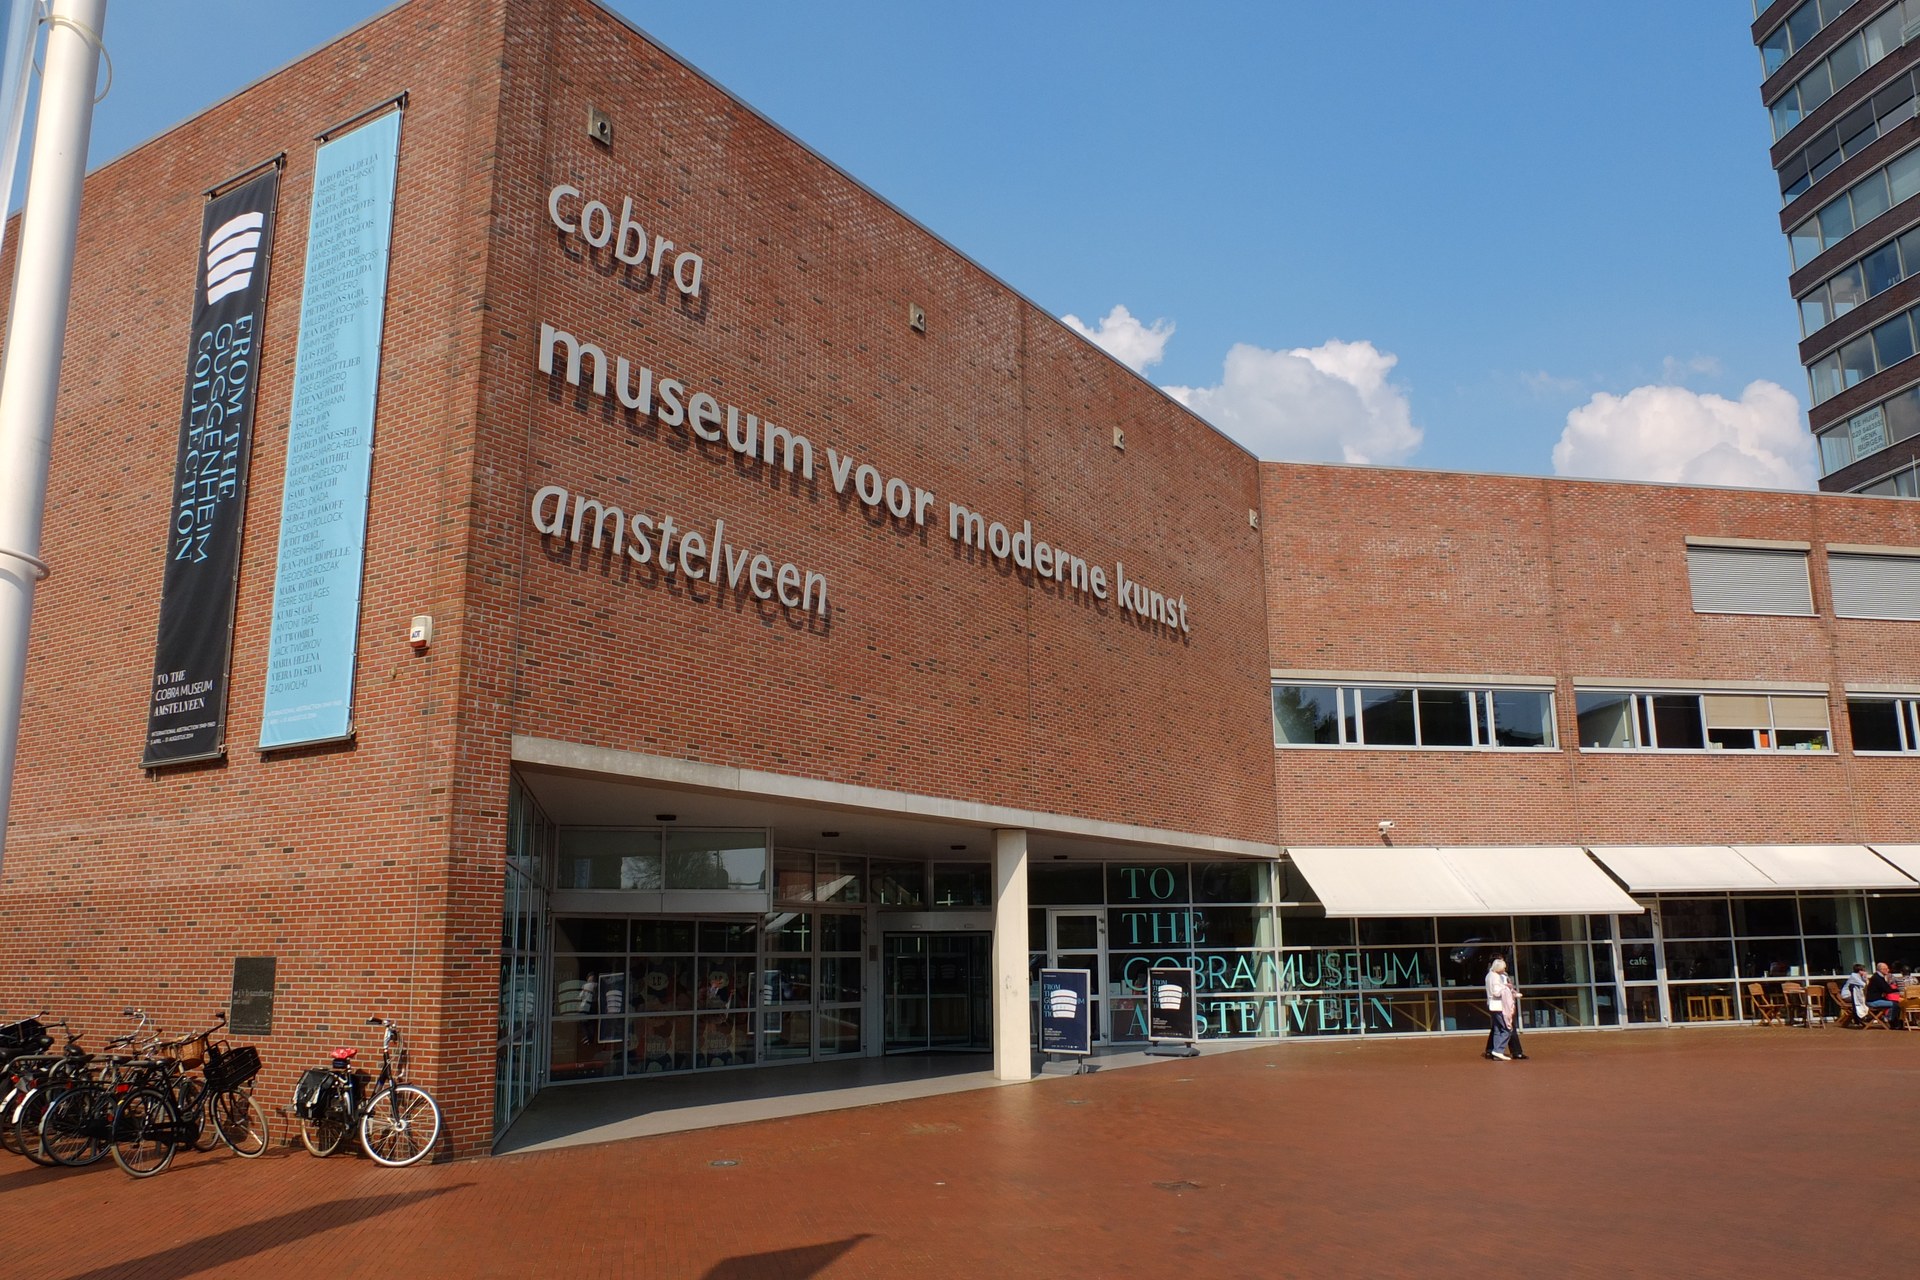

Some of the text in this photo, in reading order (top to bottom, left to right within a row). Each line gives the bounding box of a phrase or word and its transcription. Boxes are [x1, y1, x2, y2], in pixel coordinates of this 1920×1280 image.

[548, 183, 702, 298] cobra
[217, 312, 253, 503] FROM THE
[175, 331, 213, 560] COLLECTION
[194, 323, 233, 563] GUGGENHEIM
[538, 322, 1189, 633] museum voor moderne kunst
[531, 485, 827, 616] amstelveen
[412, 630, 422, 638] ADT
[155, 680, 213, 702] COBRA MUSEUM
[157, 670, 186, 685] TO THE
[153, 697, 205, 717] AMSTELVEEN
[1120, 867, 1175, 900] TO
[1121, 911, 1206, 945] THE
[1266, 951, 1420, 988] MUSEUM
[1629, 956, 1648, 966] café
[1126, 996, 1394, 1036] ASTELVEEN
